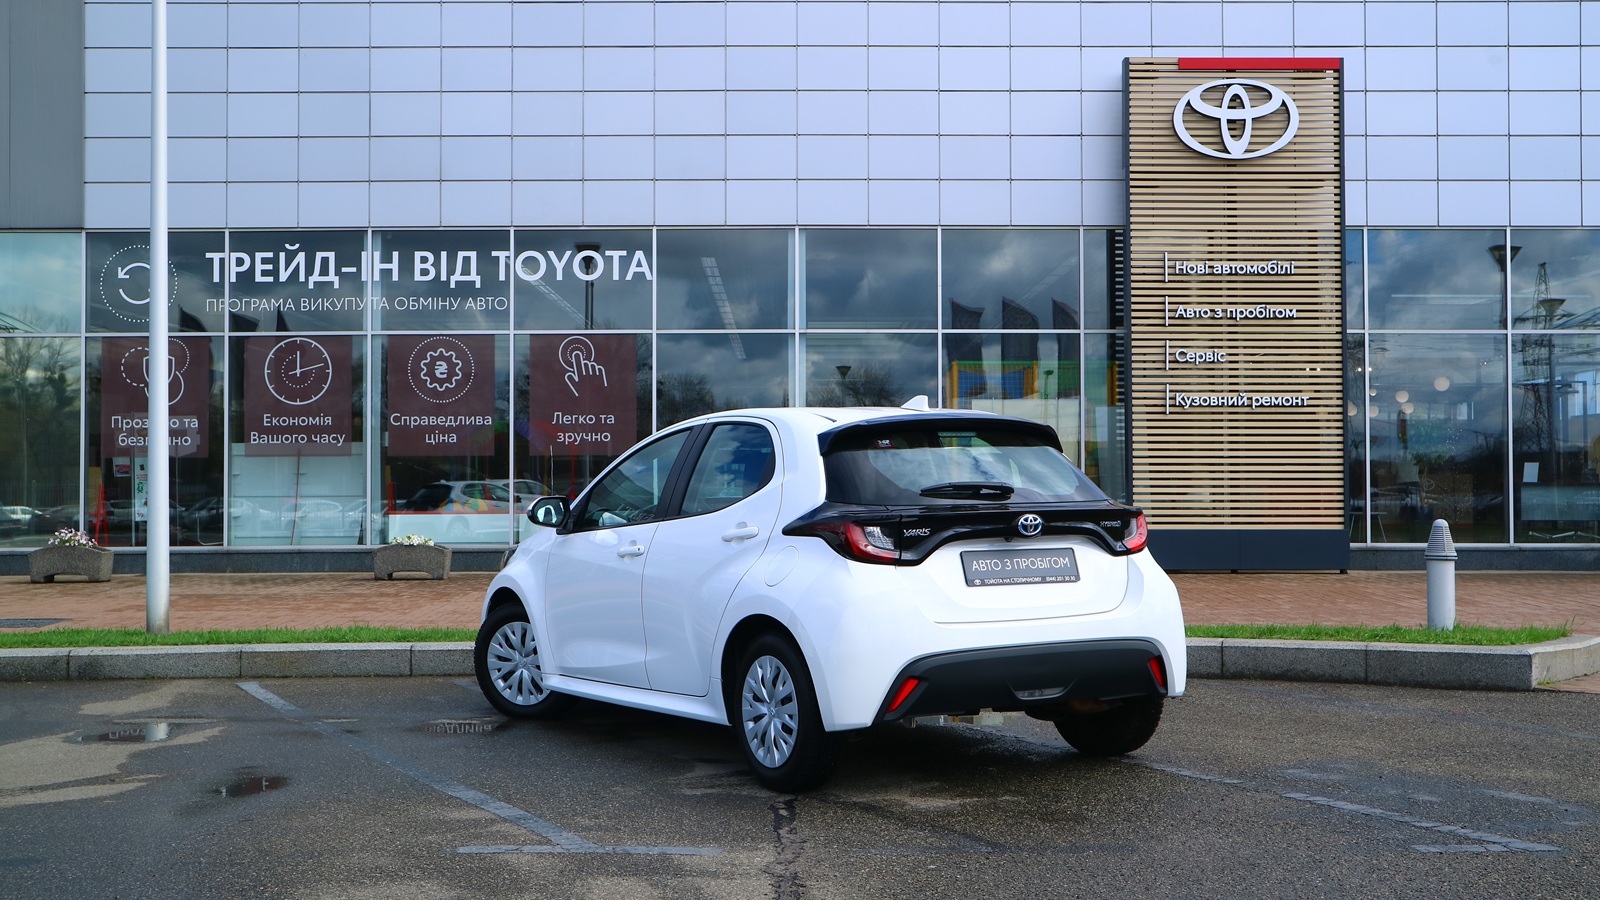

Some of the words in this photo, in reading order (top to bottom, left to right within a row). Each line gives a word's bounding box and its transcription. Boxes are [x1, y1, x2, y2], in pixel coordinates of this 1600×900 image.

[205, 243, 399, 289] ТРЕЙД-ІН
[414, 250, 481, 289] ВІД
[491, 250, 653, 281] TOYOTA
[1175, 261, 1208, 274] Нові
[1213, 260, 1295, 274] автомобілі
[206, 298, 295, 312] ПРОГРАМА
[301, 297, 365, 311] ВИКУПУ
[370, 297, 389, 310] ТА
[394, 297, 461, 310] ОБМІНУ
[465, 296, 508, 310] АВТО
[1175, 305, 1210, 318] Авто
[1214, 308, 1222, 318] з
[1227, 304, 1297, 322] пробігом
[1175, 349, 1226, 365] Сервіс
[1175, 393, 1247, 409] Кузовний
[1252, 396, 1309, 409] ремонт
[111, 416, 179, 431] Прозо
[183, 418, 198, 428] та
[263, 413, 332, 426] Економія
[390, 413, 492, 428] Справедлива
[551, 411, 596, 424] Легко
[599, 414, 615, 424] та
[118, 433, 191, 446] безно
[250, 432, 307, 444] Вашого
[311, 434, 346, 446] часу
[425, 430, 457, 445] ціна
[556, 432, 611, 445] зручно
[903, 528, 931, 537] YARIS
[972, 559, 1001, 571] АВТО
[1013, 557, 1070, 569] ПРОБІГОМ
